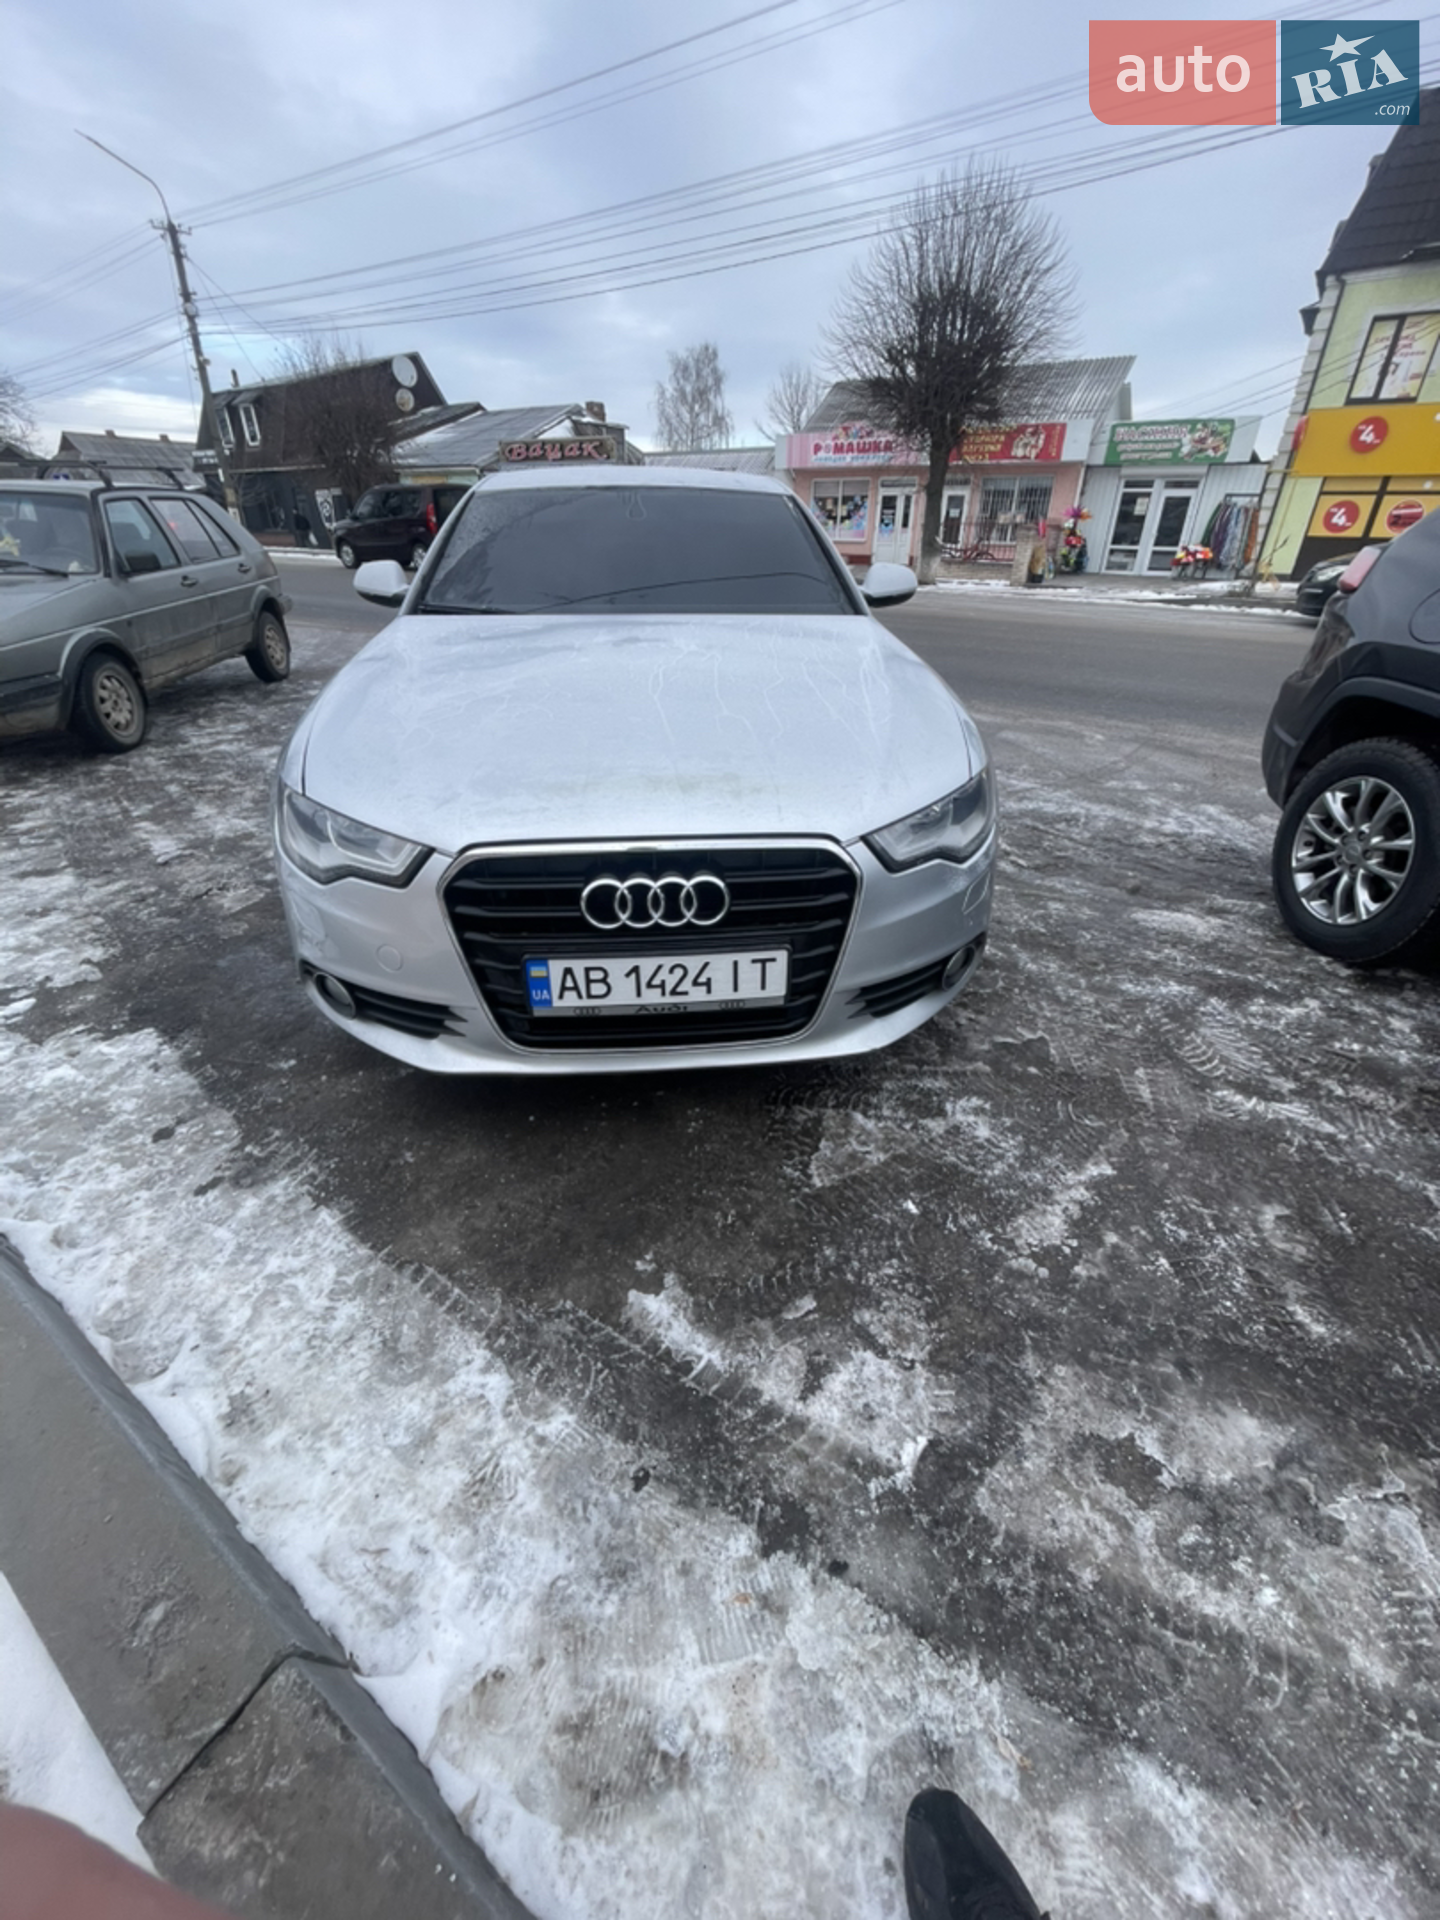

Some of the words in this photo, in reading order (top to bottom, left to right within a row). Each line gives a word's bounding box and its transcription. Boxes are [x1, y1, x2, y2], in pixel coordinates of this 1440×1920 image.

[557, 966, 612, 1001] AB
[624, 961, 712, 998] 1424
[732, 957, 777, 993] IT
[532, 989, 550, 1001] UA
[634, 1004, 688, 1014] Audi
